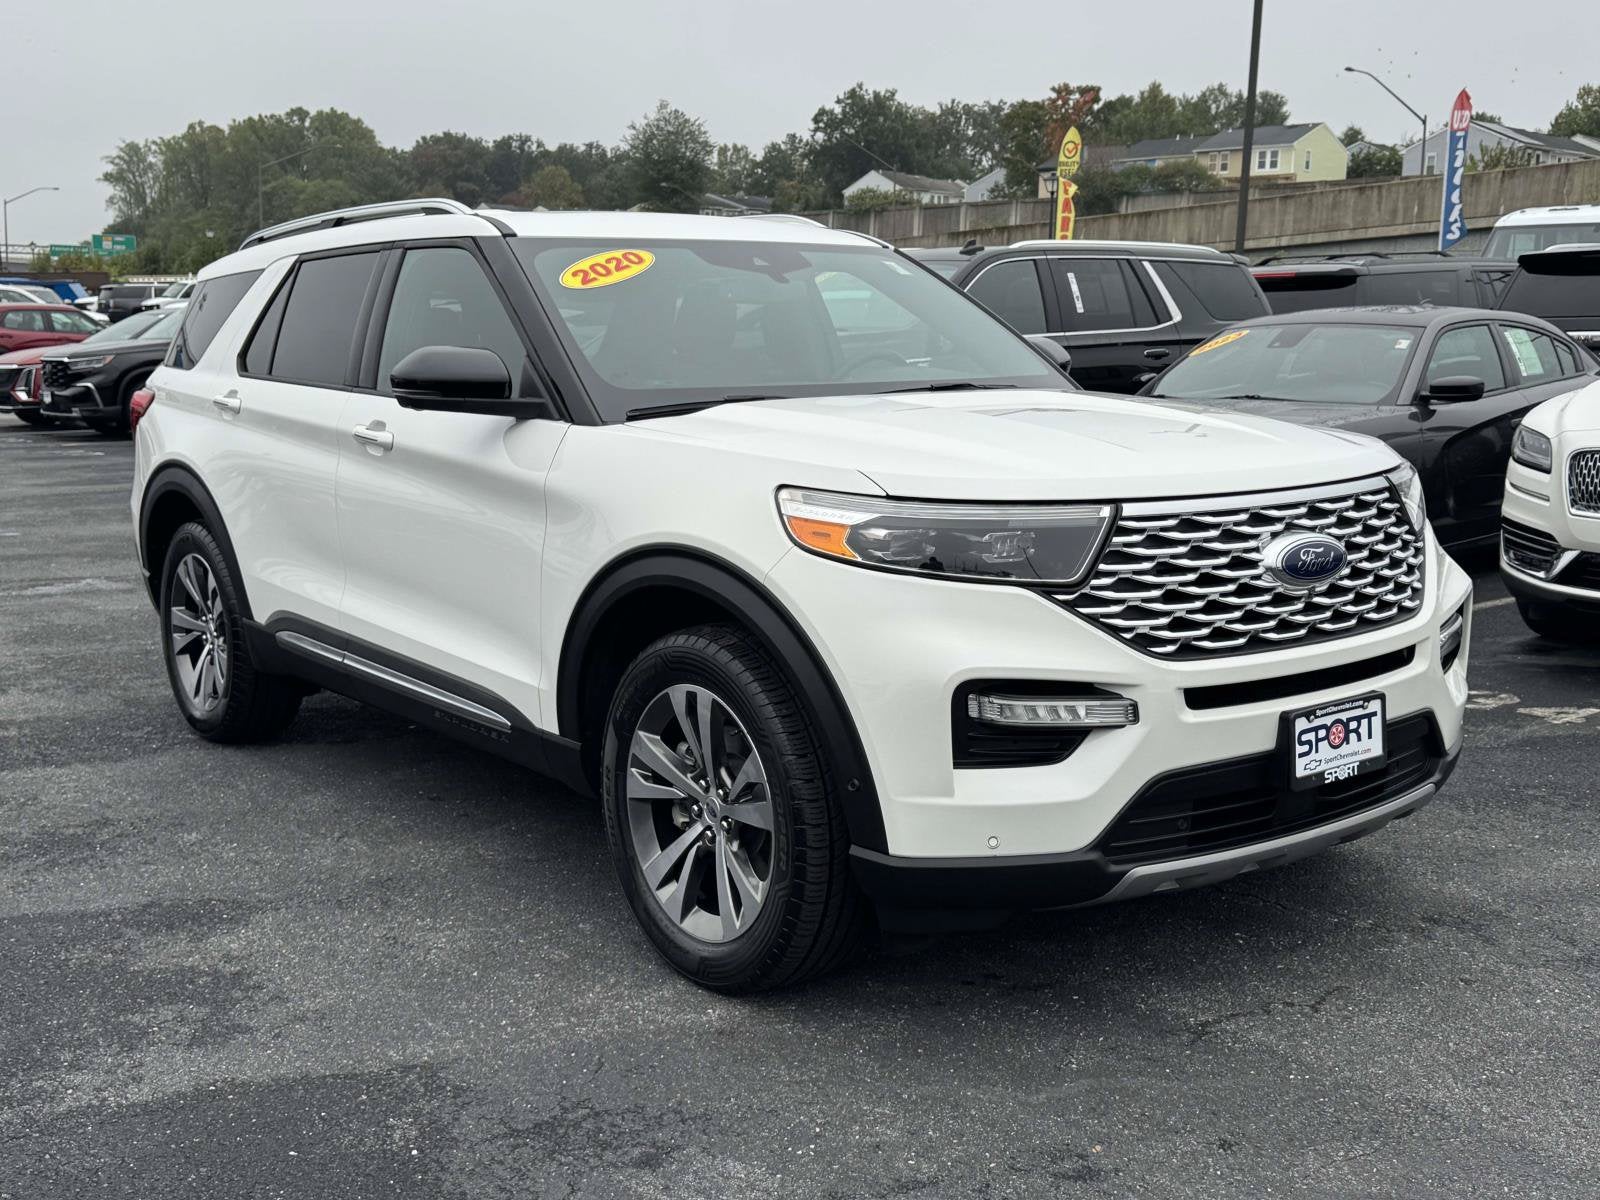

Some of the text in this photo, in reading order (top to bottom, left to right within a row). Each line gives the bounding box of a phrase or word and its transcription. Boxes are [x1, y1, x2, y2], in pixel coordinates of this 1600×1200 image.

[571, 251, 645, 286] 2020
[1297, 546, 1334, 574] Ford
[1315, 700, 1364, 716] SportChevrolet.com
[1297, 710, 1378, 759] SPORT
[1323, 747, 1372, 764] SportChevrolet.com
[1324, 762, 1360, 784] SPORT
